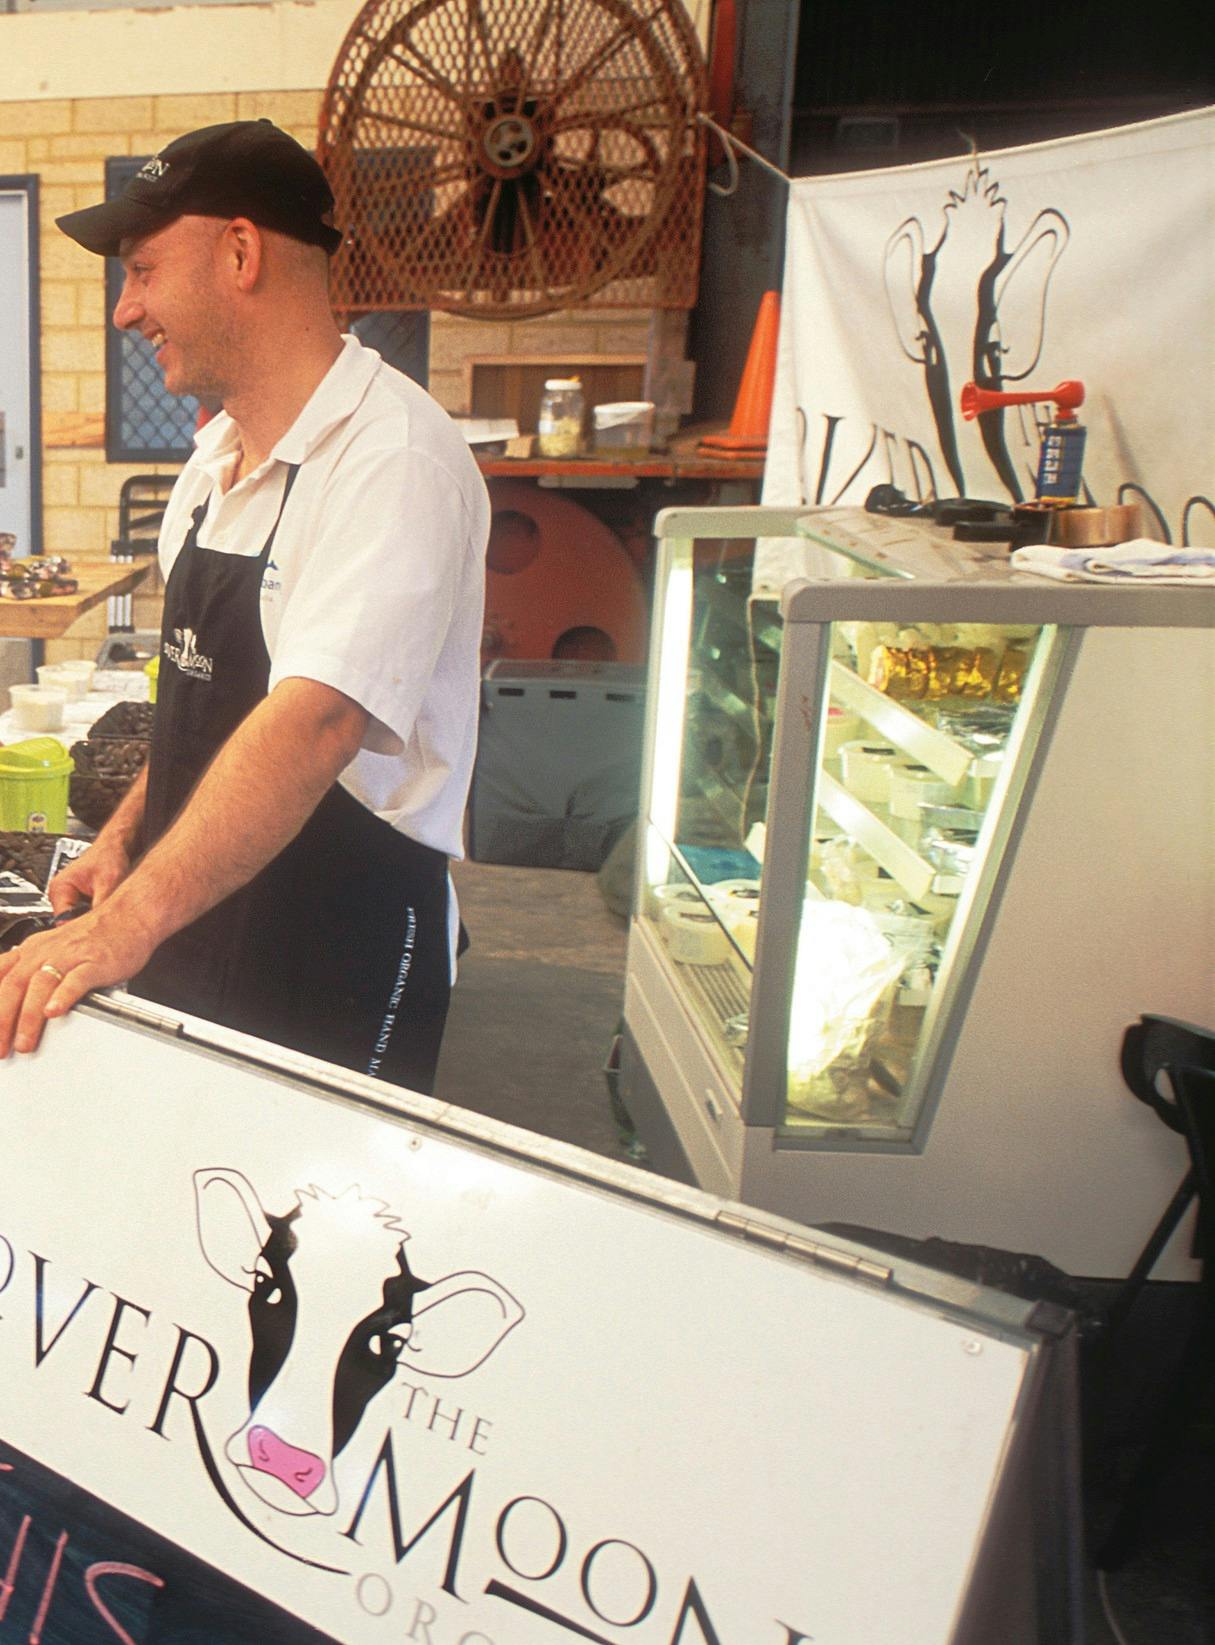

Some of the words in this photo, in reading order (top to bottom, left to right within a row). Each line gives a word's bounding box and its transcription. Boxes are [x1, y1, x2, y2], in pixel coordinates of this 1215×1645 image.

[388, 952, 413, 1009] ORGANIC
[374, 1013, 396, 1053] HAND
[401, 1381, 493, 1456] THE
